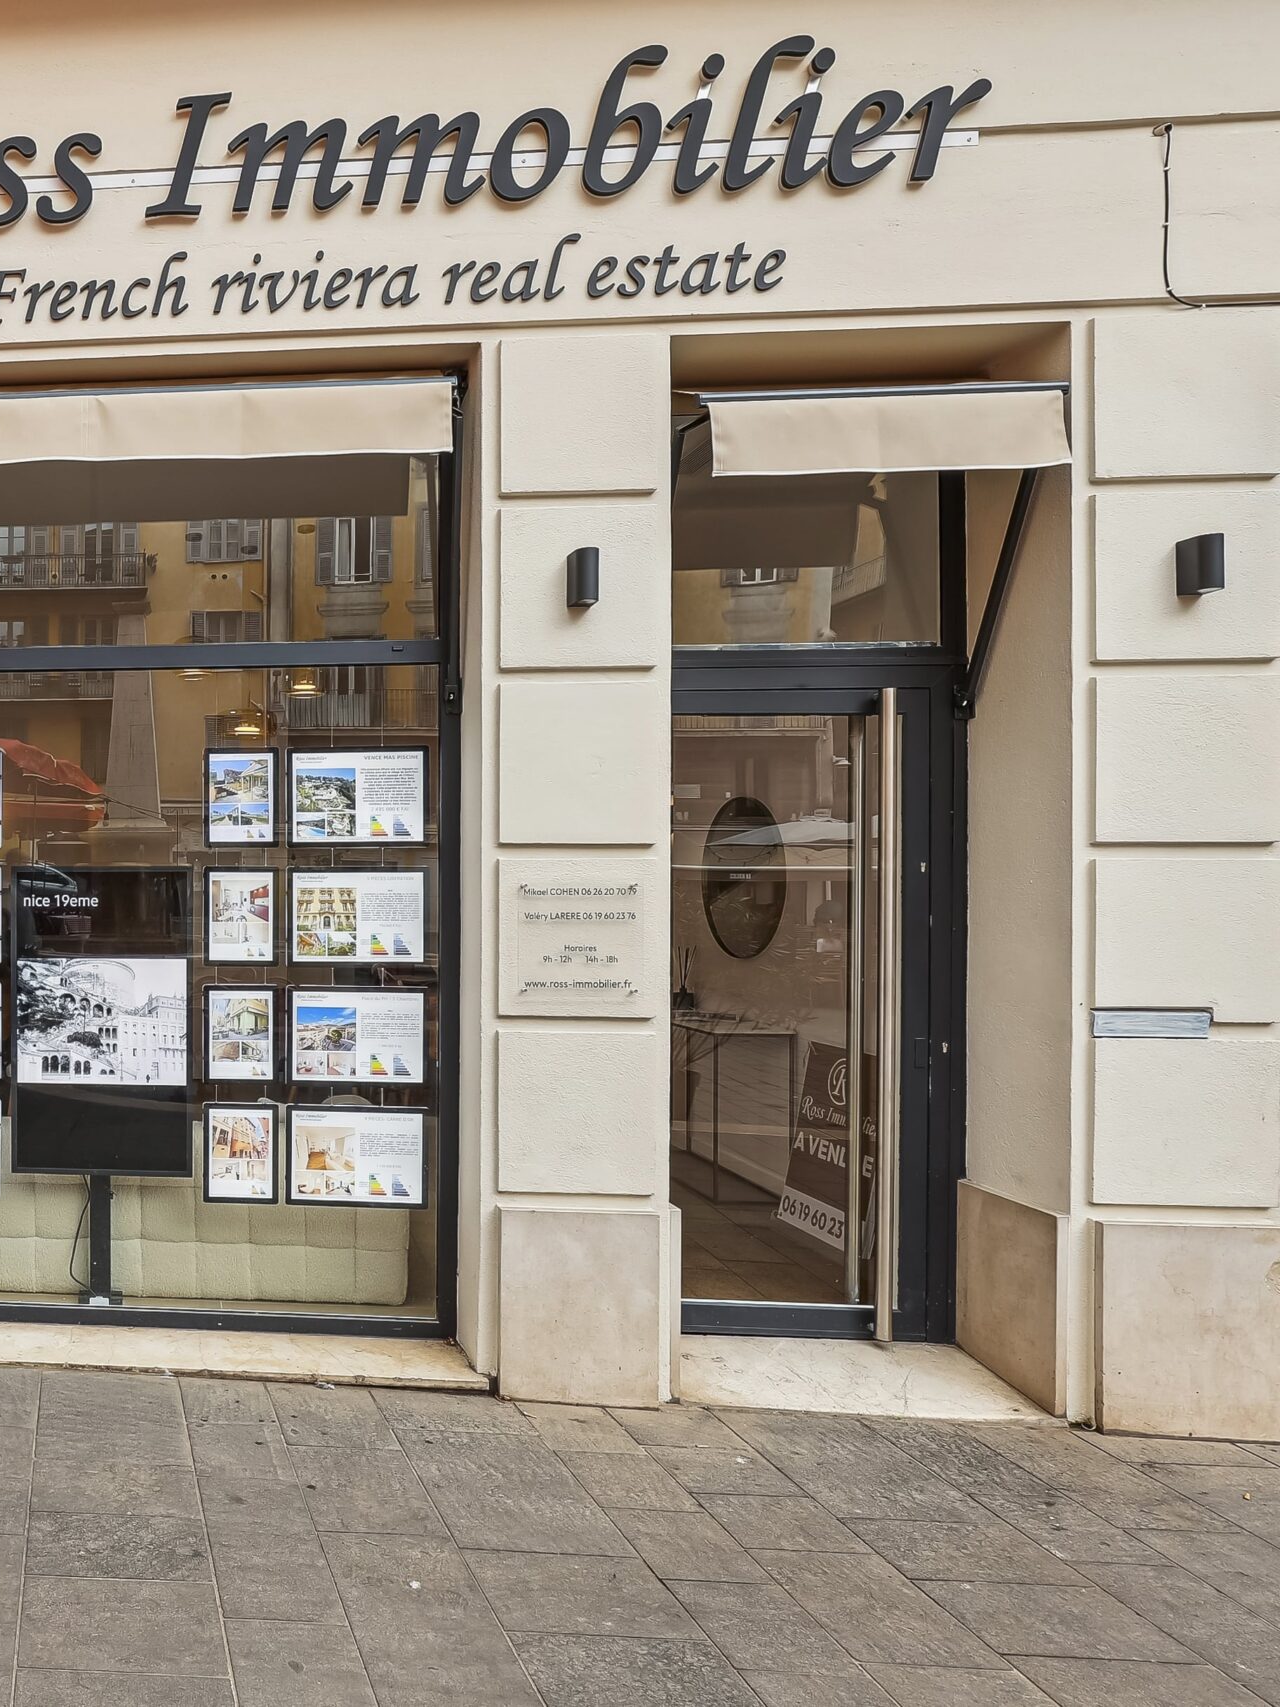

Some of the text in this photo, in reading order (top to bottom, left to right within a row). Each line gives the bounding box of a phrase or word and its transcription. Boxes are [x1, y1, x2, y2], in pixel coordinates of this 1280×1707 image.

[145, 35, 992, 224] Immobilier
[212, 250, 420, 315] riviera
[440, 233, 581, 306] real
[586, 241, 787, 300] estate
[523, 887, 638, 896] Mikael COHEN 06 26 20 70 79
[23, 894, 99, 907] nice 19eme
[524, 911, 637, 921] Valéry LARERE 06 19 60 23 76
[563, 944, 597, 952] Horaires
[542, 955, 553, 963] 9h
[559, 955, 572, 963] 12h
[585, 955, 599, 963] 14h
[605, 955, 619, 963] 18h
[524, 979, 632, 989] www.ross-immobilier.fr
[801, 1095, 826, 1121] Ross
[793, 1131, 805, 1152] A
[782, 1195, 845, 1239] 06 19 60 23
